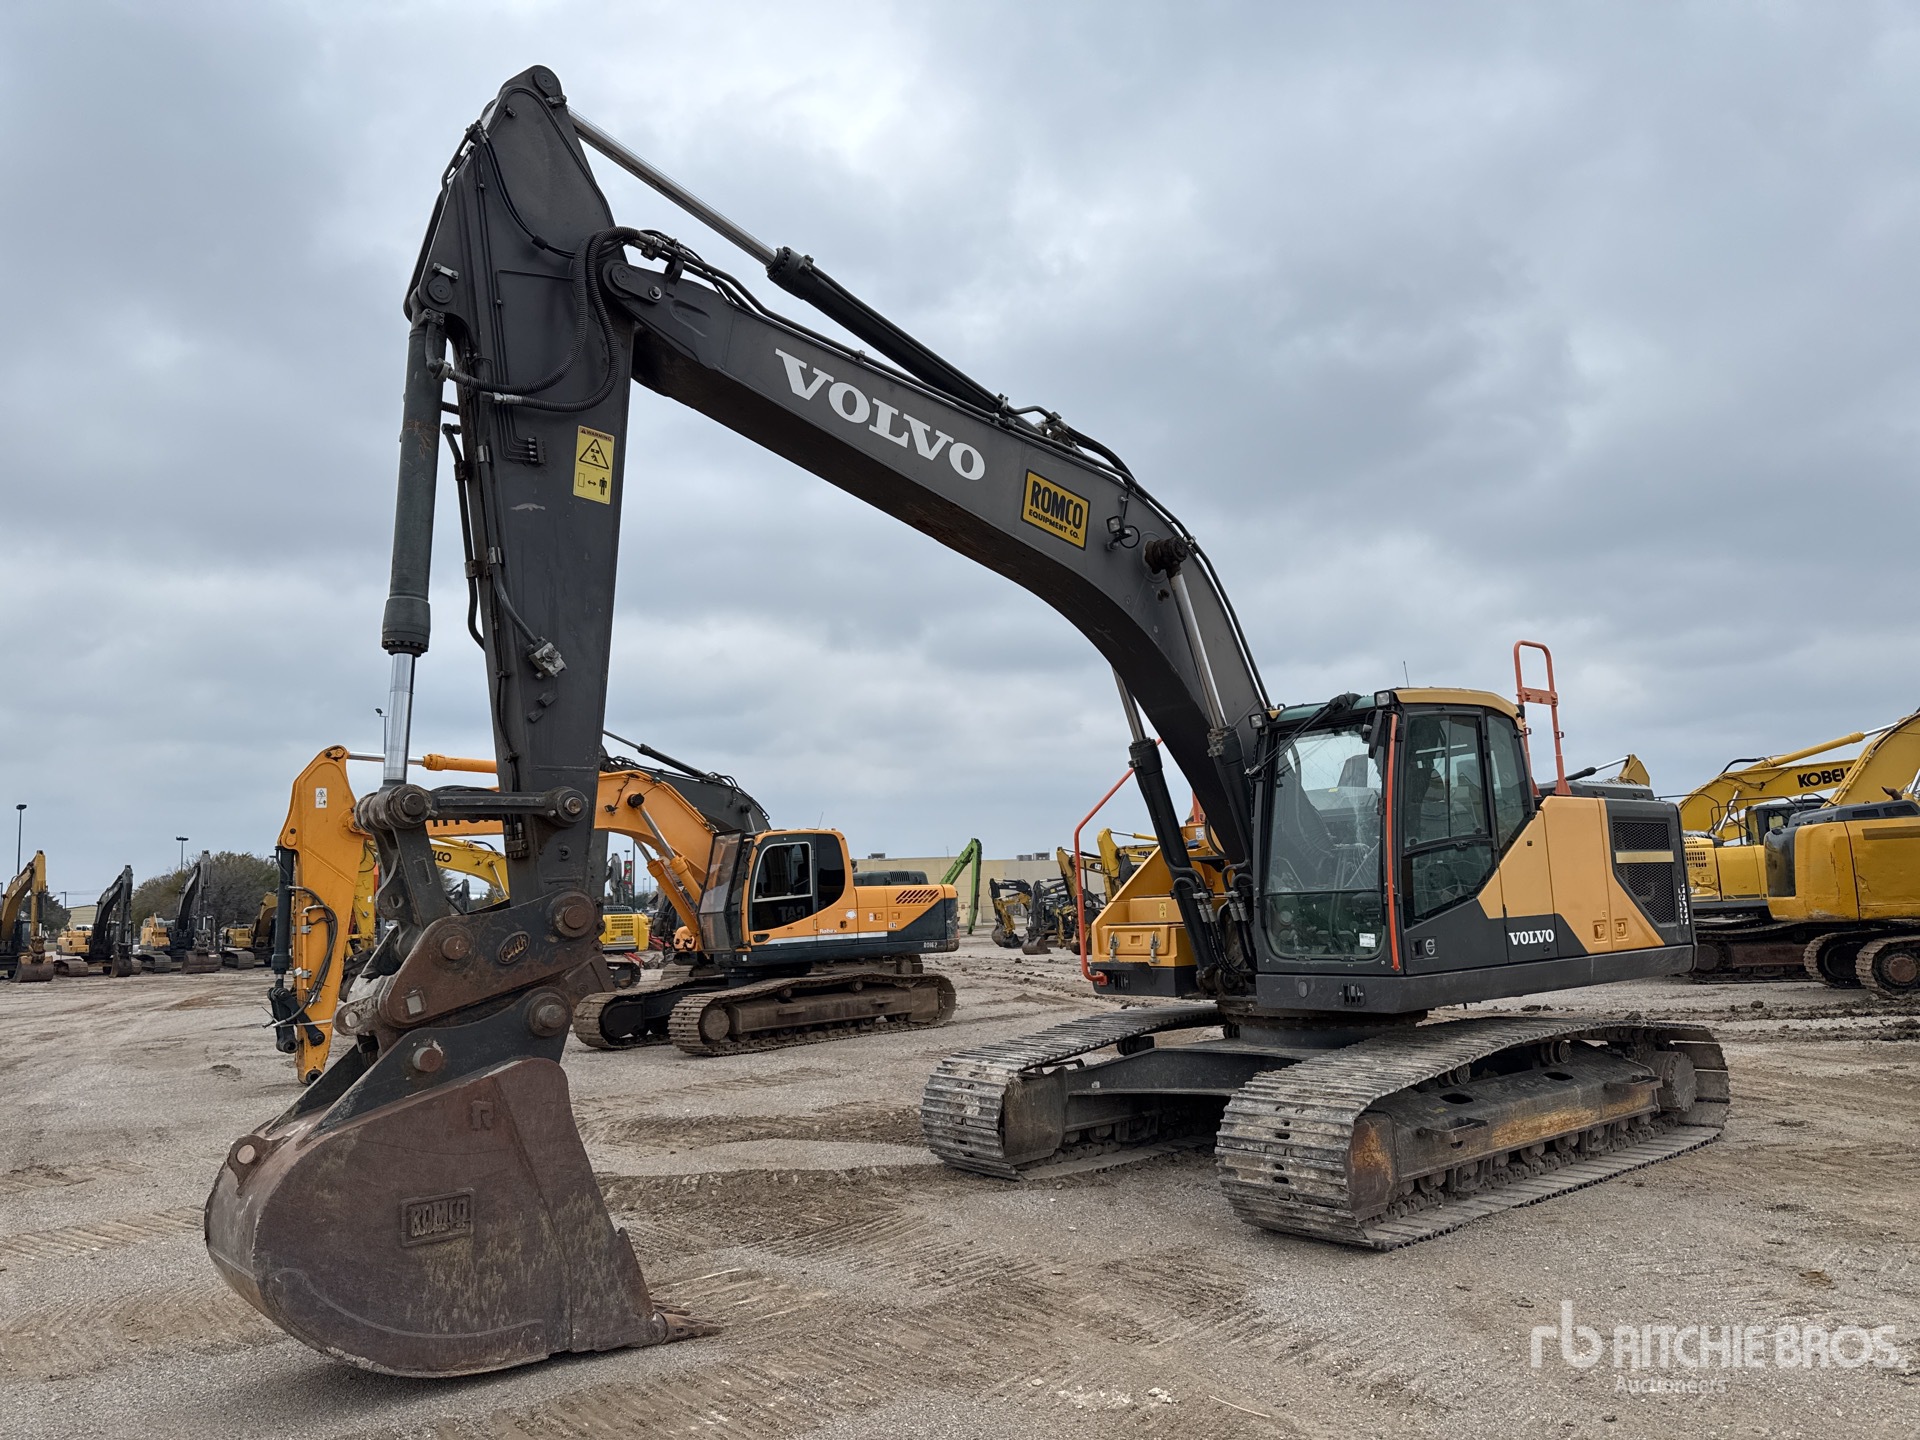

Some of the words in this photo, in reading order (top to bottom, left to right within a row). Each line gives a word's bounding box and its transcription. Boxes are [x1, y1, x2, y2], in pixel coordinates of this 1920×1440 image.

[775, 348, 985, 480] VOLVO
[586, 431, 611, 442] WARNING
[1030, 480, 1083, 529] ROMCO
[1028, 509, 1067, 533] EQUIPMENT
[1069, 529, 1080, 539] CO.
[1508, 929, 1555, 946] VOLVO
